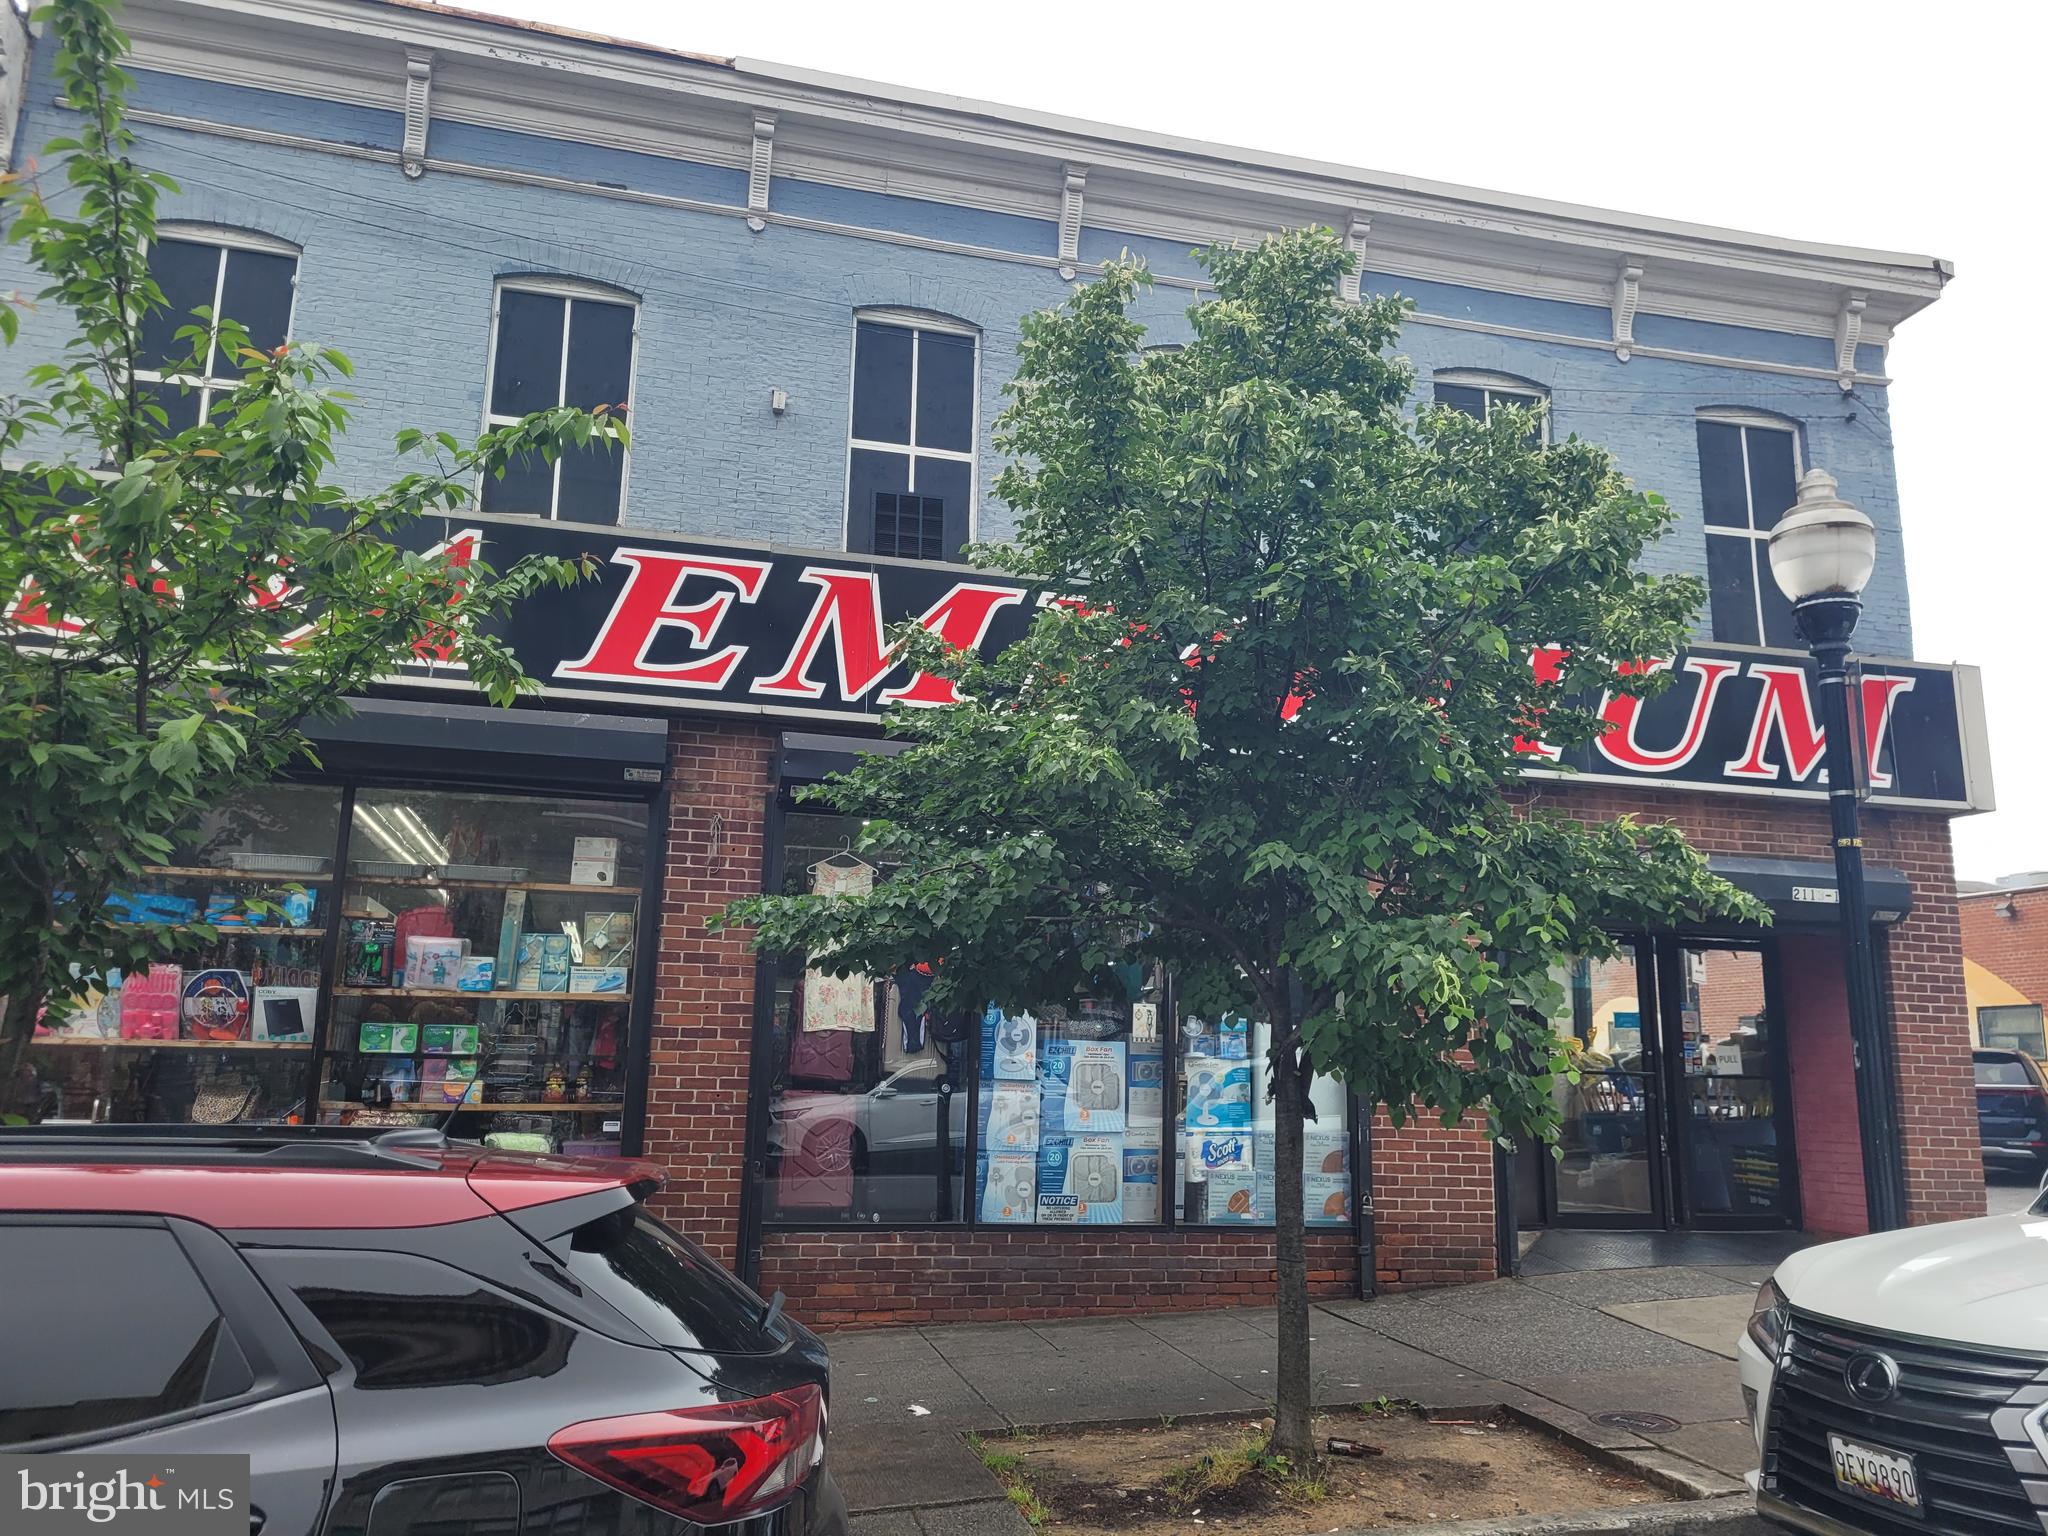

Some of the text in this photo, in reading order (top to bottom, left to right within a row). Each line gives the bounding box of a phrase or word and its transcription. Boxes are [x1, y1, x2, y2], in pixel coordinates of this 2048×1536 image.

[1793, 888, 1815, 901] 211
[1719, 1055, 1738, 1063] PULL
[1053, 1061, 1063, 1069] 20
[1207, 1138, 1237, 1161] Scott
[1041, 1196, 1077, 1205] NOTICE
